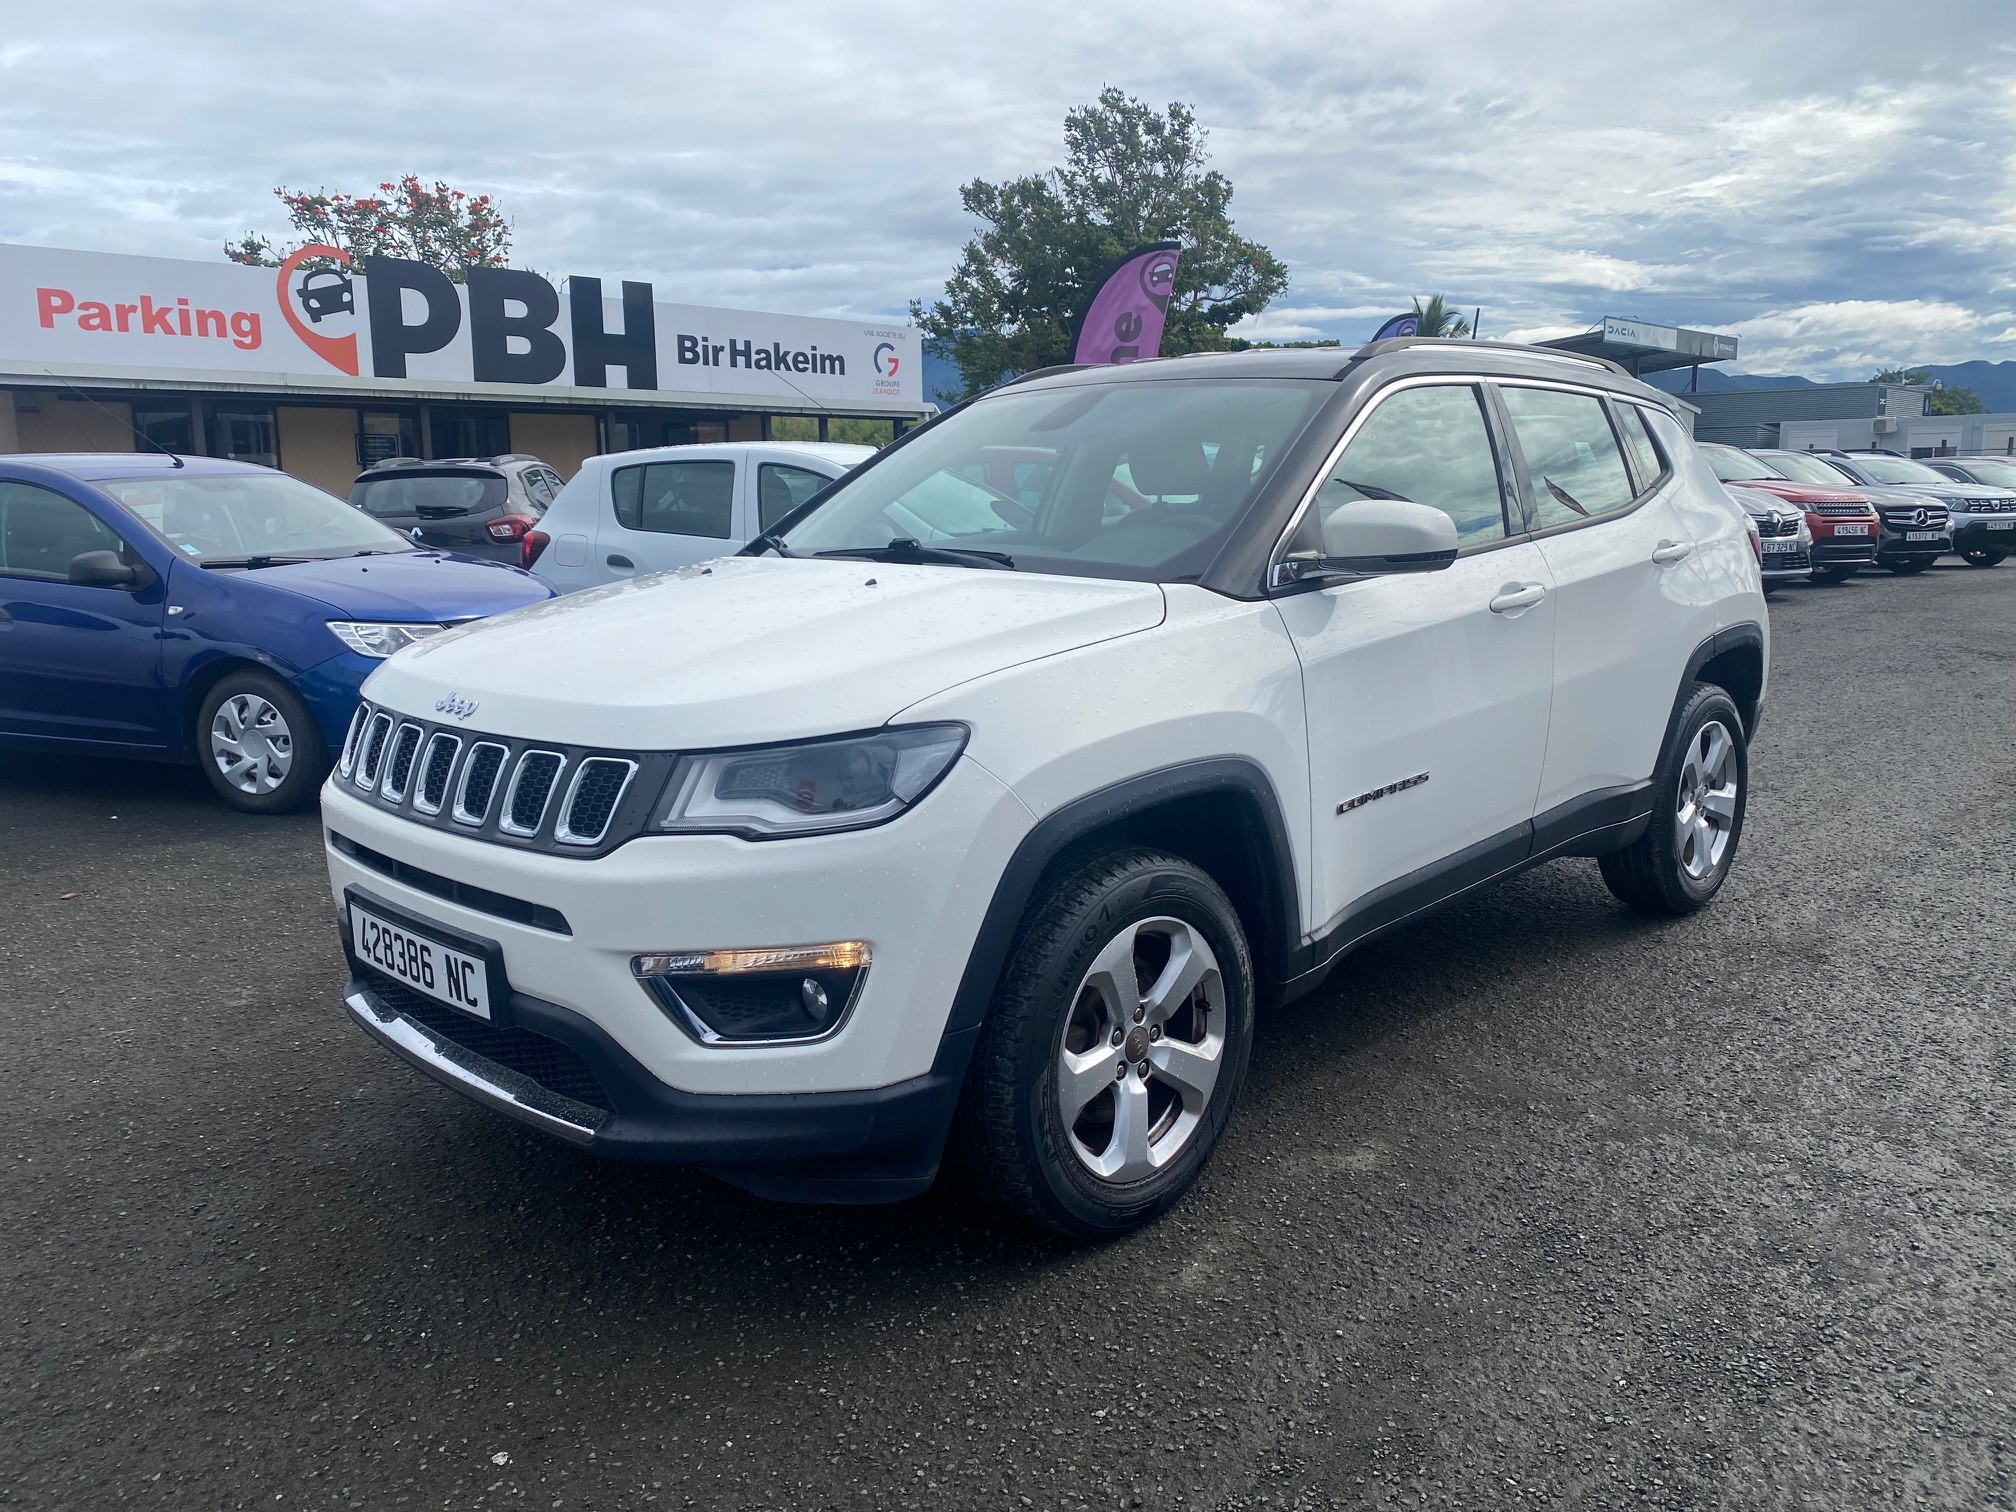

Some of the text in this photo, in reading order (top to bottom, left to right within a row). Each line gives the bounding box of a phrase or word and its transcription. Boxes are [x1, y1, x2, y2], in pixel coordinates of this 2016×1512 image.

[36, 287, 262, 350] Parking
[365, 255, 655, 389] PBH
[1607, 325, 1636, 338] DACIA
[677, 334, 847, 376] Bir Hakeim
[875, 379, 900, 388] GROUPE
[435, 690, 479, 721] Jeep
[361, 916, 478, 1008] 428386 NC
